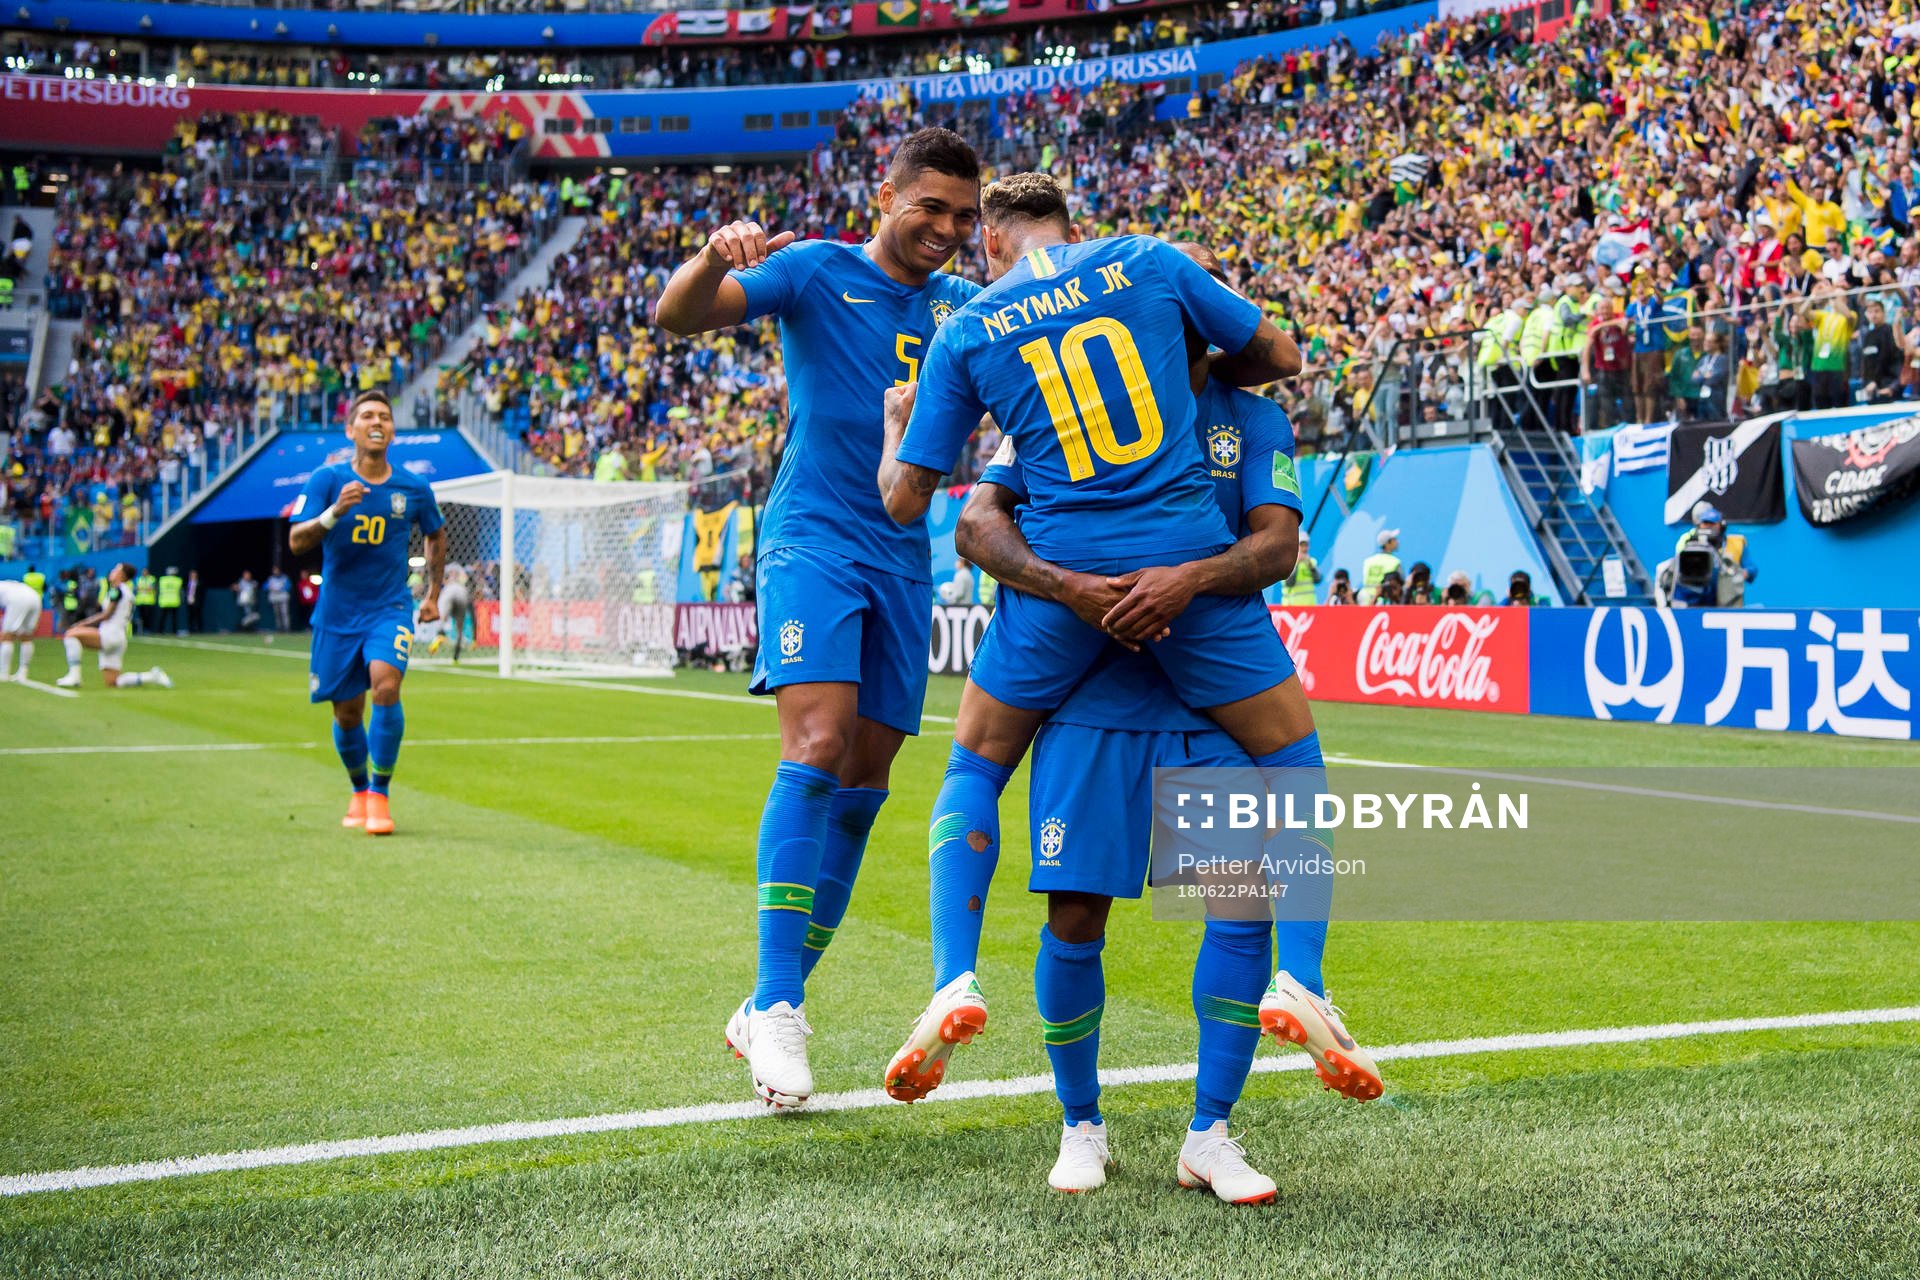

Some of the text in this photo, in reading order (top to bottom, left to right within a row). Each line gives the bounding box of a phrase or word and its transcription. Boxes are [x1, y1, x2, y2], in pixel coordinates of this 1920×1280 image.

[0, 77, 191, 109] ETERSBURG
[916, 79, 963, 99] FIFA
[970, 66, 1054, 96] WORLD
[1059, 62, 1105, 88] CUP
[1111, 51, 1196, 79] RUSSIA
[982, 261, 1133, 342] NEYMAR JR
[894, 333, 922, 387] 5
[1018, 316, 1164, 482] 10
[1211, 469, 1237, 480] BRASI
[352, 514, 386, 545] 20
[1356, 611, 1500, 702] Coca-Cola
[1702, 608, 1911, 740] 万达
